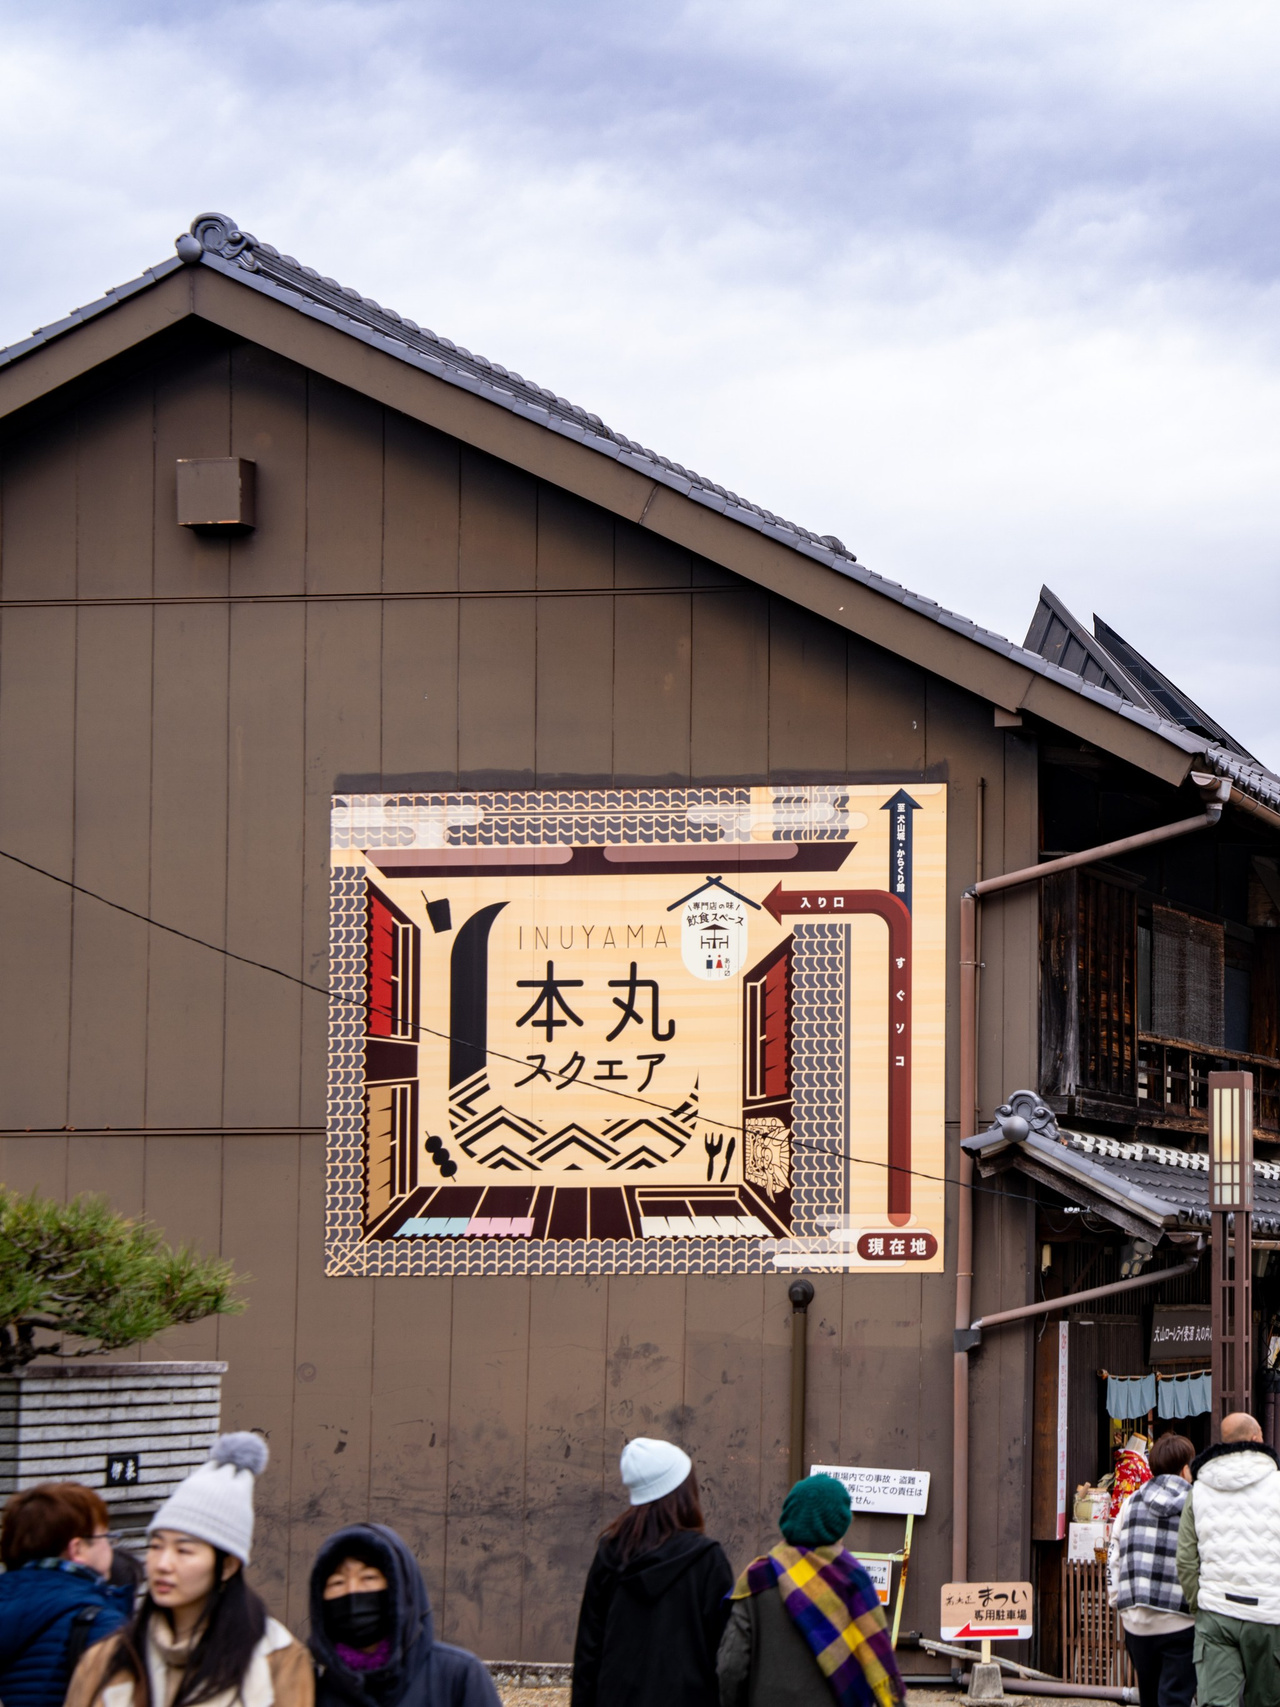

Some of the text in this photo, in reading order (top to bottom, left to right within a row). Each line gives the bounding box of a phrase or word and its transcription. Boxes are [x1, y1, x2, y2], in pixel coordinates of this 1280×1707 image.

[897, 803, 905, 812] 至
[692, 901, 734, 910] 専門店の味
[800, 897, 844, 908] 入り口
[686, 912, 744, 927] 飲食スペース
[519, 925, 668, 949] INUYAMA
[515, 960, 676, 1043] 本丸
[895, 957, 906, 1067] すぐソコ
[514, 1051, 667, 1091] スクエア
[867, 1237, 928, 1257] 現在地
[845, 1483, 923, 1497] 等についての責任は
[978, 1586, 1029, 1608] まつい
[974, 1608, 1028, 1621] 専用駐車場
